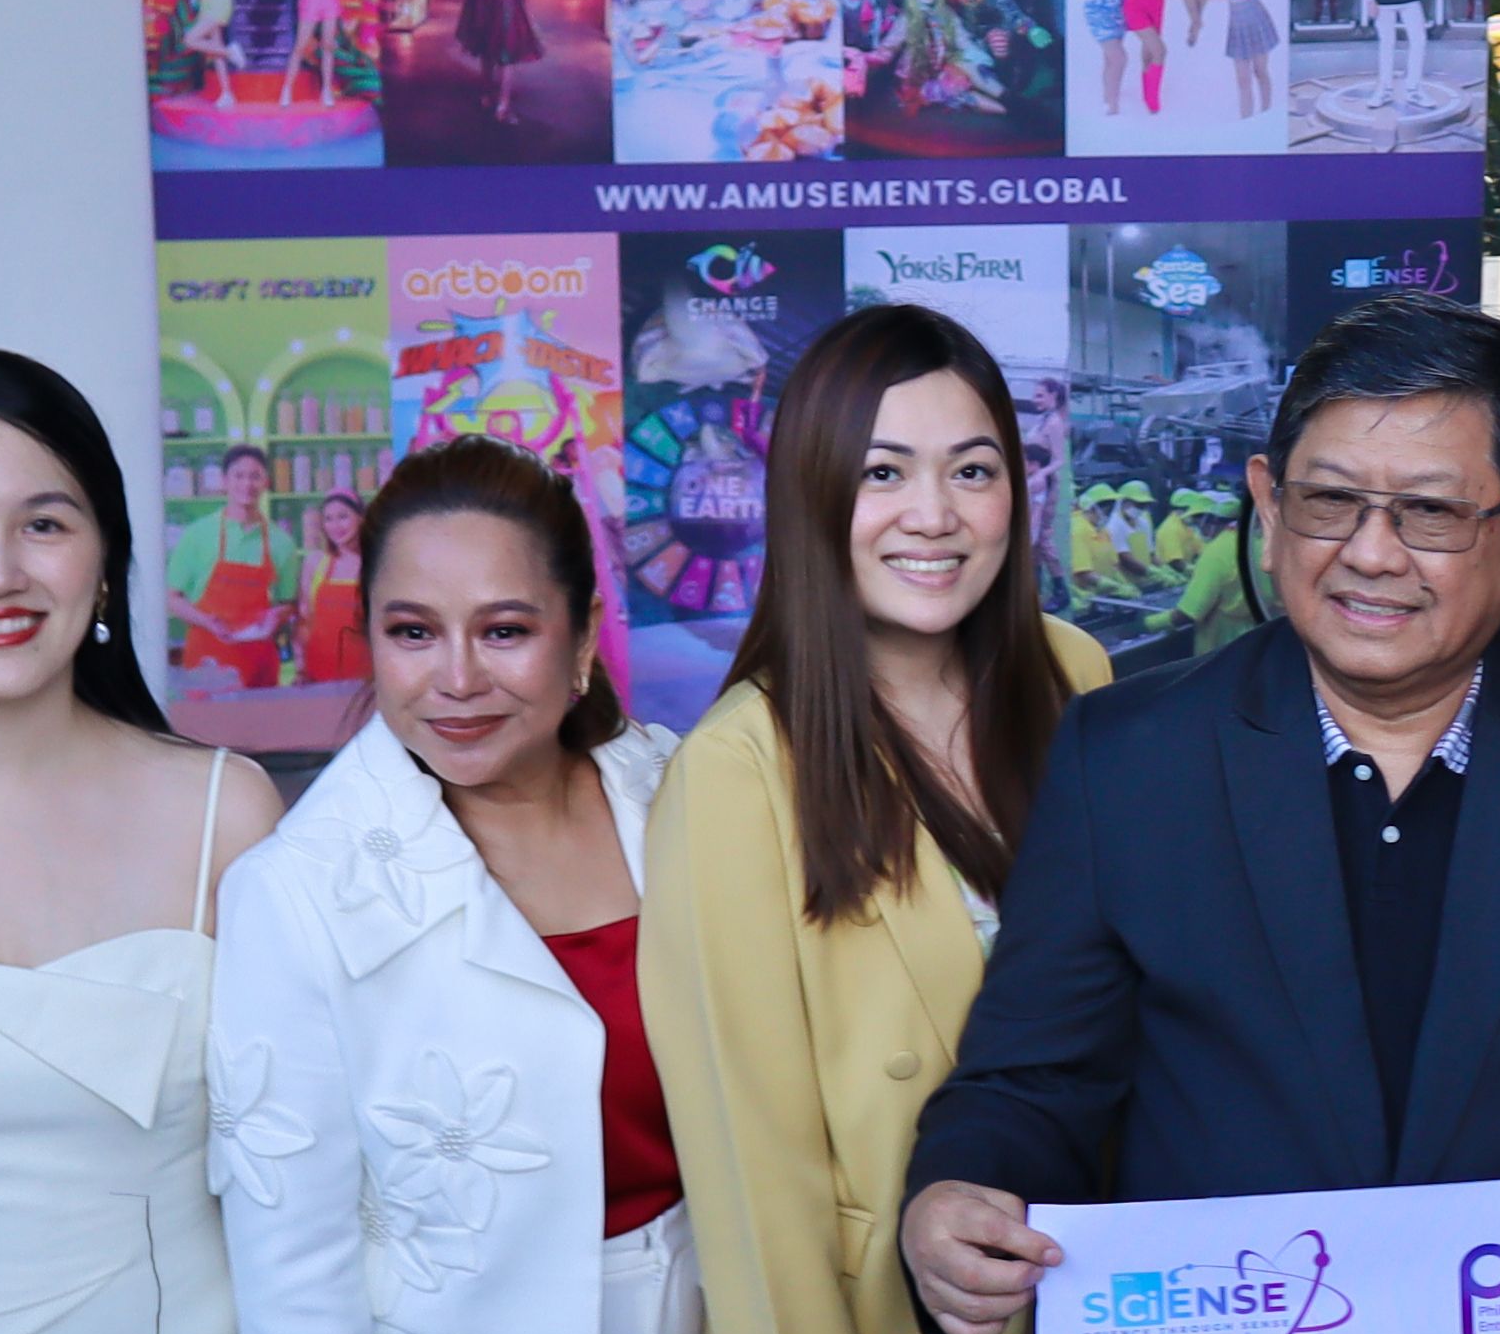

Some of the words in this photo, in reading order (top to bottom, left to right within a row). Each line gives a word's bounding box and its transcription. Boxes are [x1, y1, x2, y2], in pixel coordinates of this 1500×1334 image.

[596, 177, 1128, 212] WWW.AMUSEMENTS.GLOBAL
[404, 264, 586, 298] artboom
[1148, 279, 1208, 307] Sea
[687, 296, 778, 312] CHANGE
[1241, 1318, 1290, 1330] SENSE
